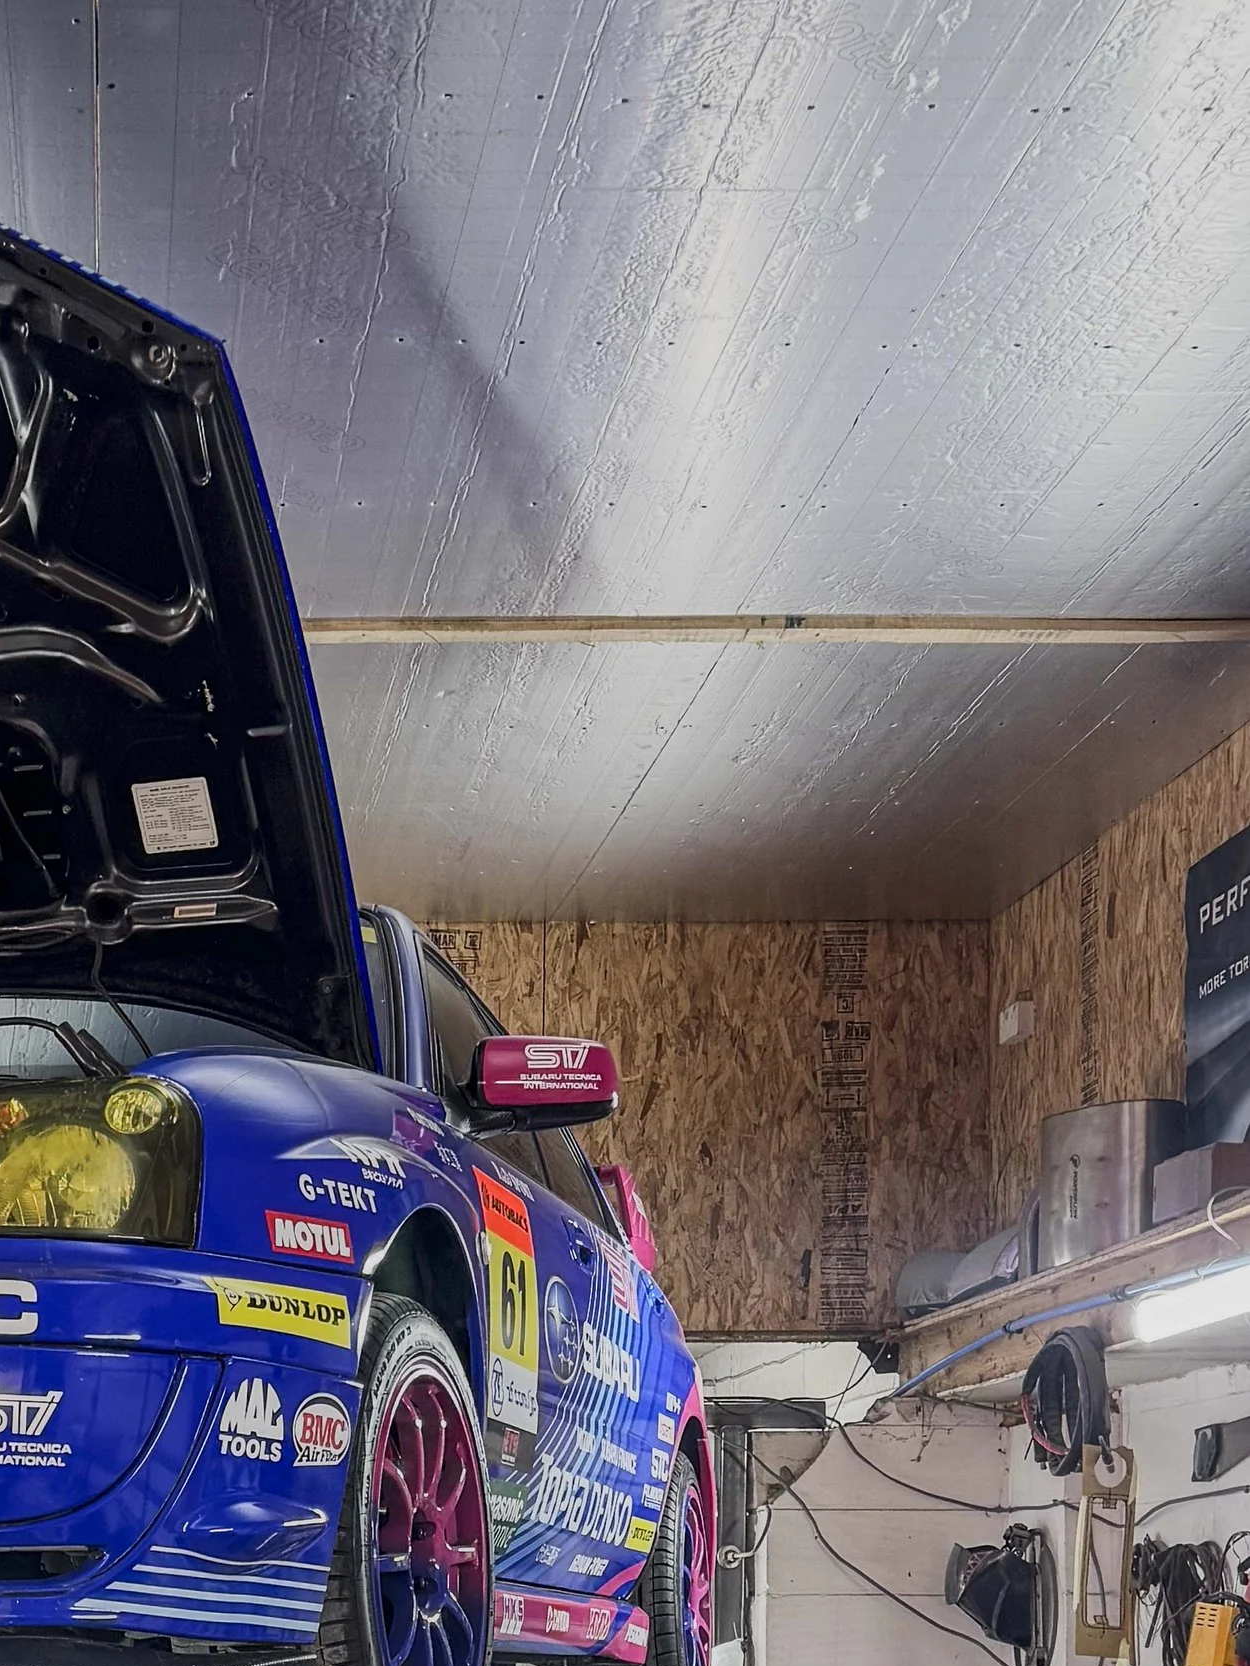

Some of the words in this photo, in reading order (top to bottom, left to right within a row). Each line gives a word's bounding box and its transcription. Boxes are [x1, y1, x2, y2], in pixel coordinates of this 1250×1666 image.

[1198, 970, 1227, 1000] MORE
[520, 1073, 562, 1081] SUBARU
[563, 1073, 602, 1081] TECNICA
[523, 1082, 599, 1090] INTERNATIONAL
[298, 1173, 378, 1214] G-TEKT
[490, 1196, 529, 1235] AUTOBACS
[274, 1217, 352, 1258] MOTUL
[246, 1291, 347, 1327] DUNLOP
[501, 1251, 527, 1357] 61
[583, 1320, 640, 1403] SUBARU
[219, 1377, 285, 1442] MAC
[9, 1441, 72, 1455] TECNICA
[218, 1434, 282, 1463] TOOLS
[300, 1412, 345, 1450] BMC
[651, 1447, 670, 1483] STC
[582, 1481, 633, 1546] DENSO
